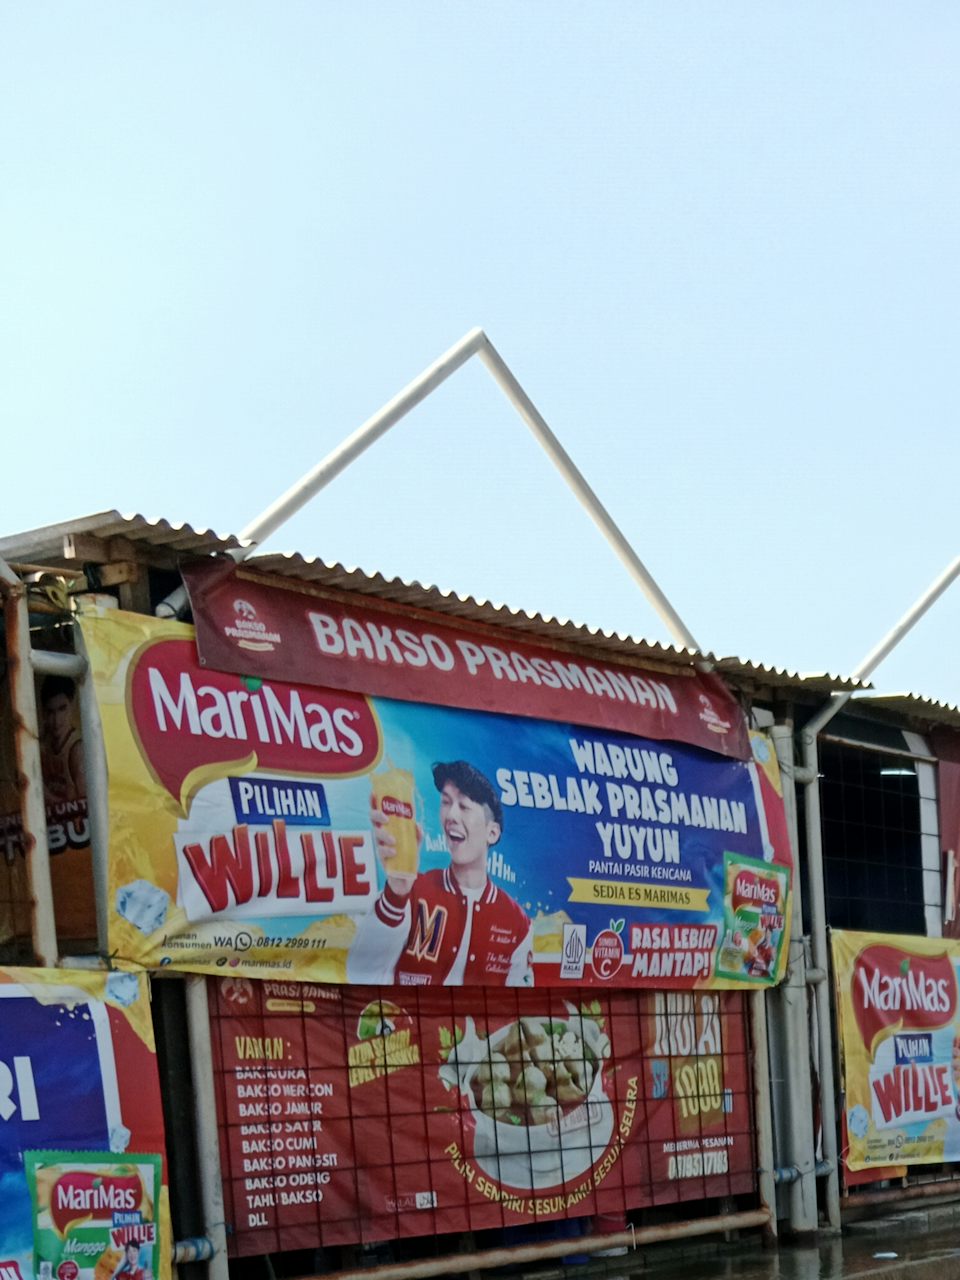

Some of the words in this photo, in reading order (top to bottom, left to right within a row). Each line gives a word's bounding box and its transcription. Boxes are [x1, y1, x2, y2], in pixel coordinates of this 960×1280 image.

[307, 611, 455, 673] BAKSO
[456, 639, 679, 715] PRASMANAN
[147, 666, 364, 758] MariMas
[568, 738, 679, 788] WARUNG
[238, 781, 323, 819] PILIHAN
[496, 767, 602, 816] SEBLAK
[606, 781, 748, 835] PRASMANAN
[595, 821, 681, 866] YUYUN
[182, 818, 372, 914] WILLIE
[589, 859, 623, 876] PANTAI
[624, 863, 650, 879] PASIR
[651, 865, 692, 882] KENCANA
[593, 884, 626, 901] SEDIA
[628, 887, 642, 902] ES
[643, 888, 691, 905] MARIMAS
[736, 877, 776, 903] MariMas
[214, 936, 233, 948] WA
[311, 939, 327, 949] 111
[406, 899, 448, 962] M
[632, 927, 671, 949] RASA
[674, 928, 716, 949] LEBIH
[595, 947, 621, 959] VITAMIN
[632, 951, 710, 978] MANTAP!
[601, 959, 612, 976] C
[859, 967, 950, 1012] MariMas
[873, 1060, 953, 1123] WILLIE
[619, 1076, 638, 1137] SELERA
[286, 1137, 317, 1150] CUMI
[57, 1184, 136, 1210] MariMas
[248, 1213, 268, 1228] DLL
[111, 1224, 155, 1248] WILLIE
